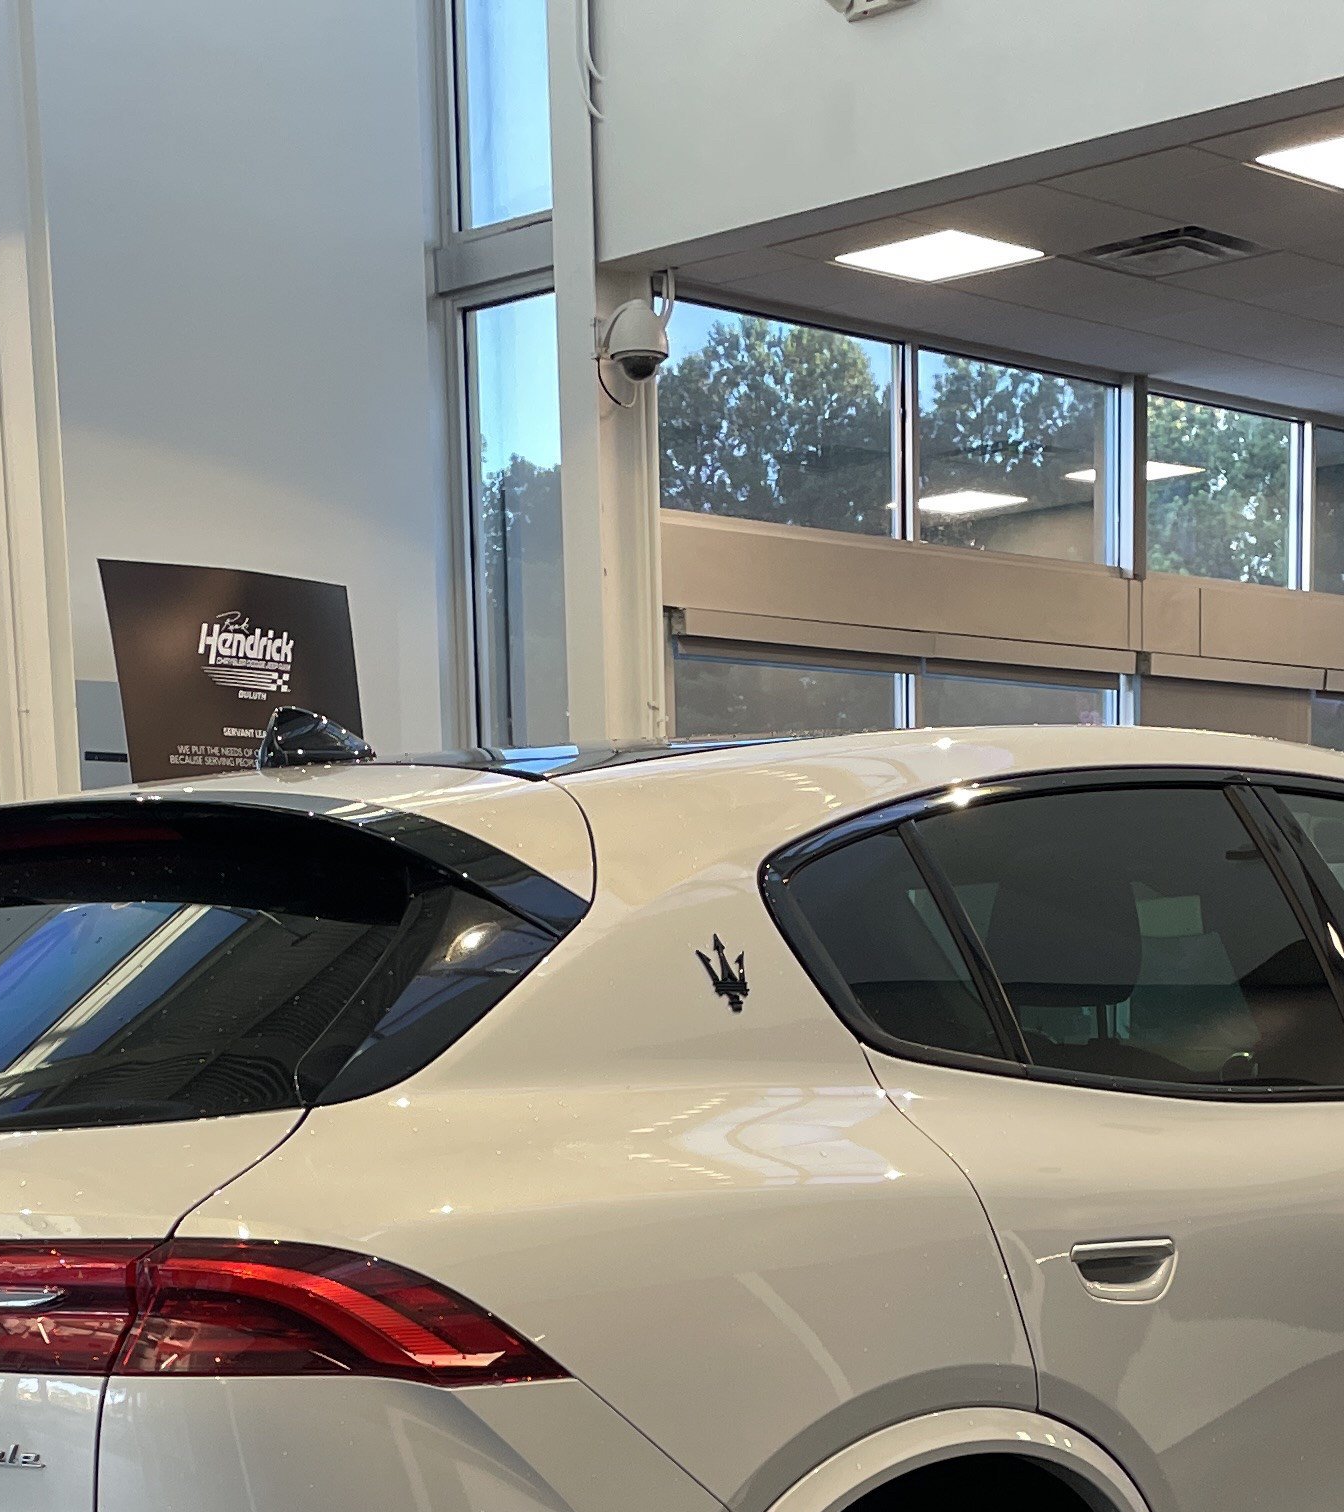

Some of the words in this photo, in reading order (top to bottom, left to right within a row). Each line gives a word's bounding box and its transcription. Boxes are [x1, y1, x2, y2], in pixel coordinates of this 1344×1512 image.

[197, 622, 295, 665] Hendrick
[238, 690, 267, 701] DULUTH
[223, 727, 254, 738] SERVANT
[177, 745, 190, 754] WE
[191, 746, 204, 755] PUT
[206, 746, 220, 756] THE
[221, 747, 243, 757] NEEDS
[169, 754, 203, 765] BECAUSE
[204, 756, 234, 767] SERVING
